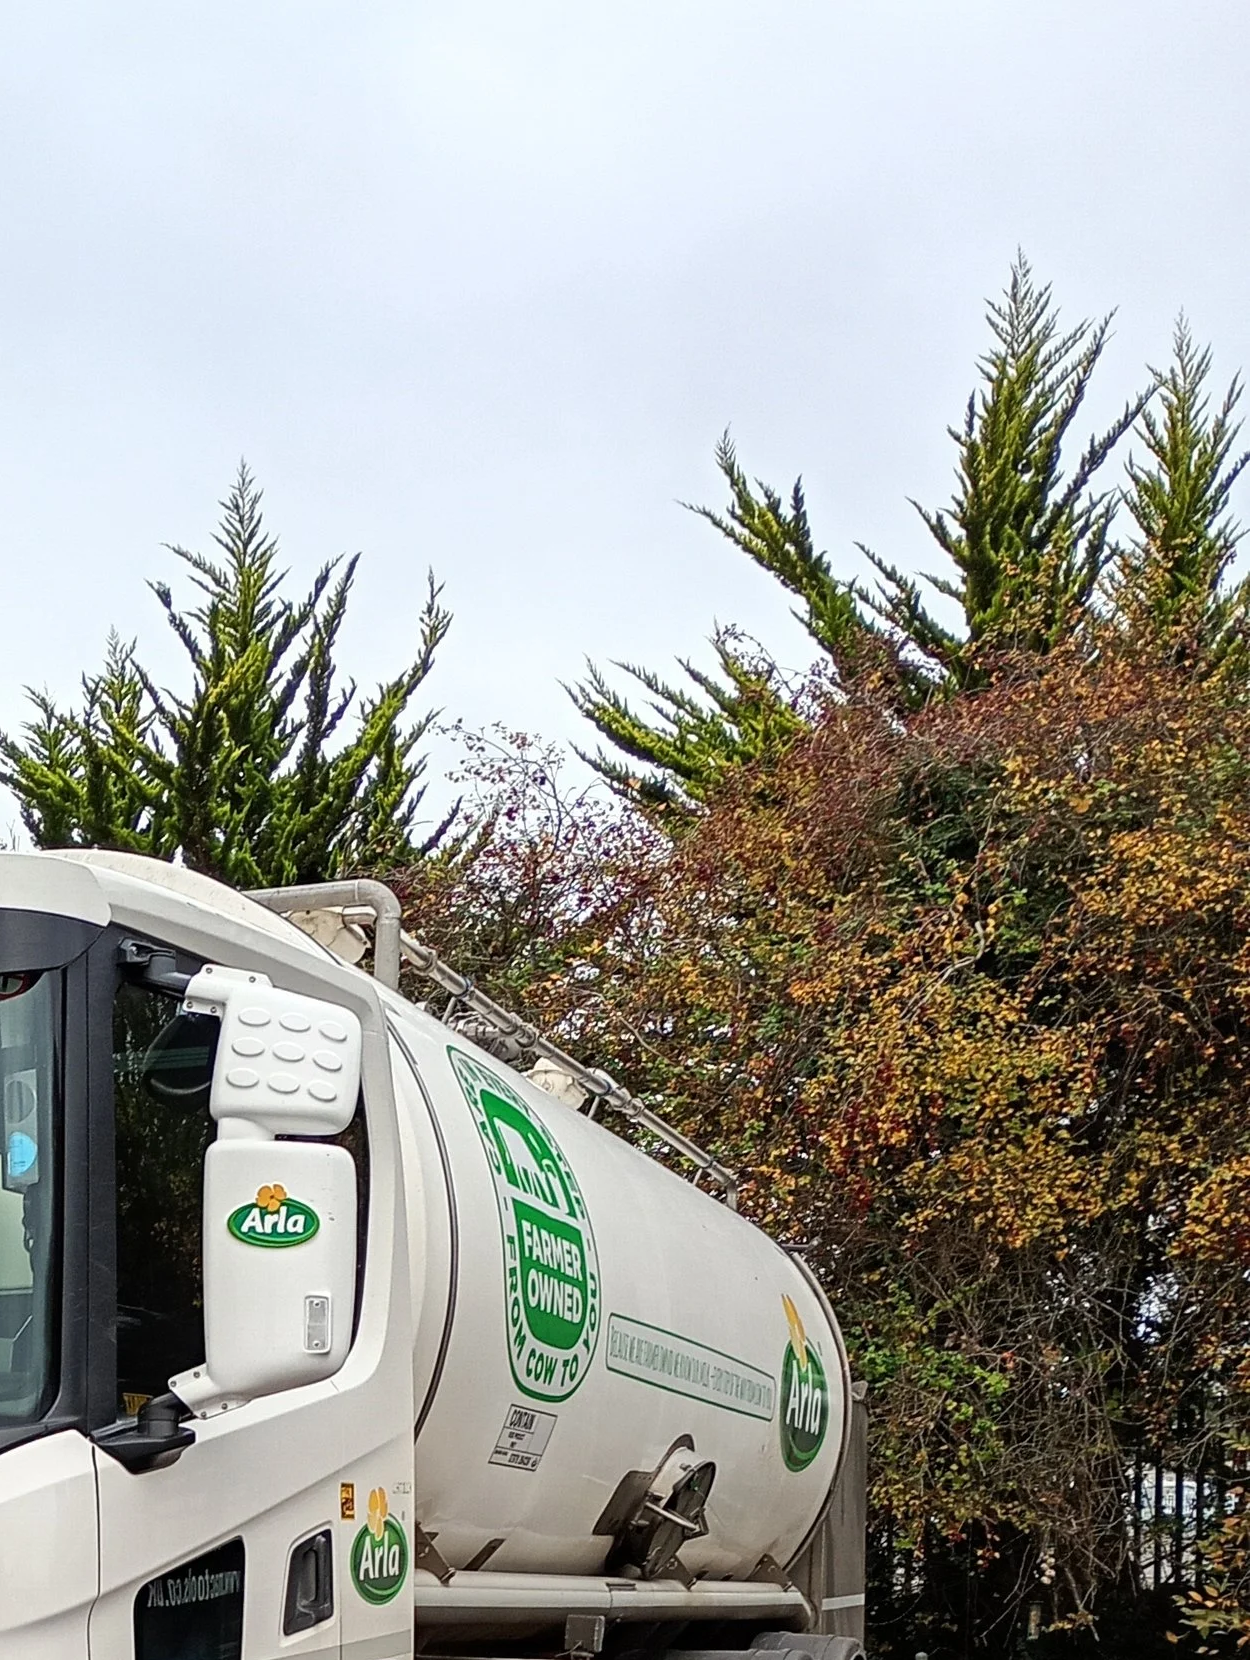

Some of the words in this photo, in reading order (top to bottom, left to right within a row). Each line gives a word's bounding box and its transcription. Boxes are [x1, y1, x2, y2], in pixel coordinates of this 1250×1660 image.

[240, 1205, 306, 1233] Arla
[521, 1219, 583, 1281] FARMER
[506, 1235, 527, 1361] FROM
[525, 1348, 558, 1386] COW
[560, 1353, 579, 1387] TO
[582, 1271, 597, 1355] YOU
[527, 1267, 583, 1324] OWNED
[785, 1359, 822, 1436] Arla
[359, 1530, 400, 1581] Arla
